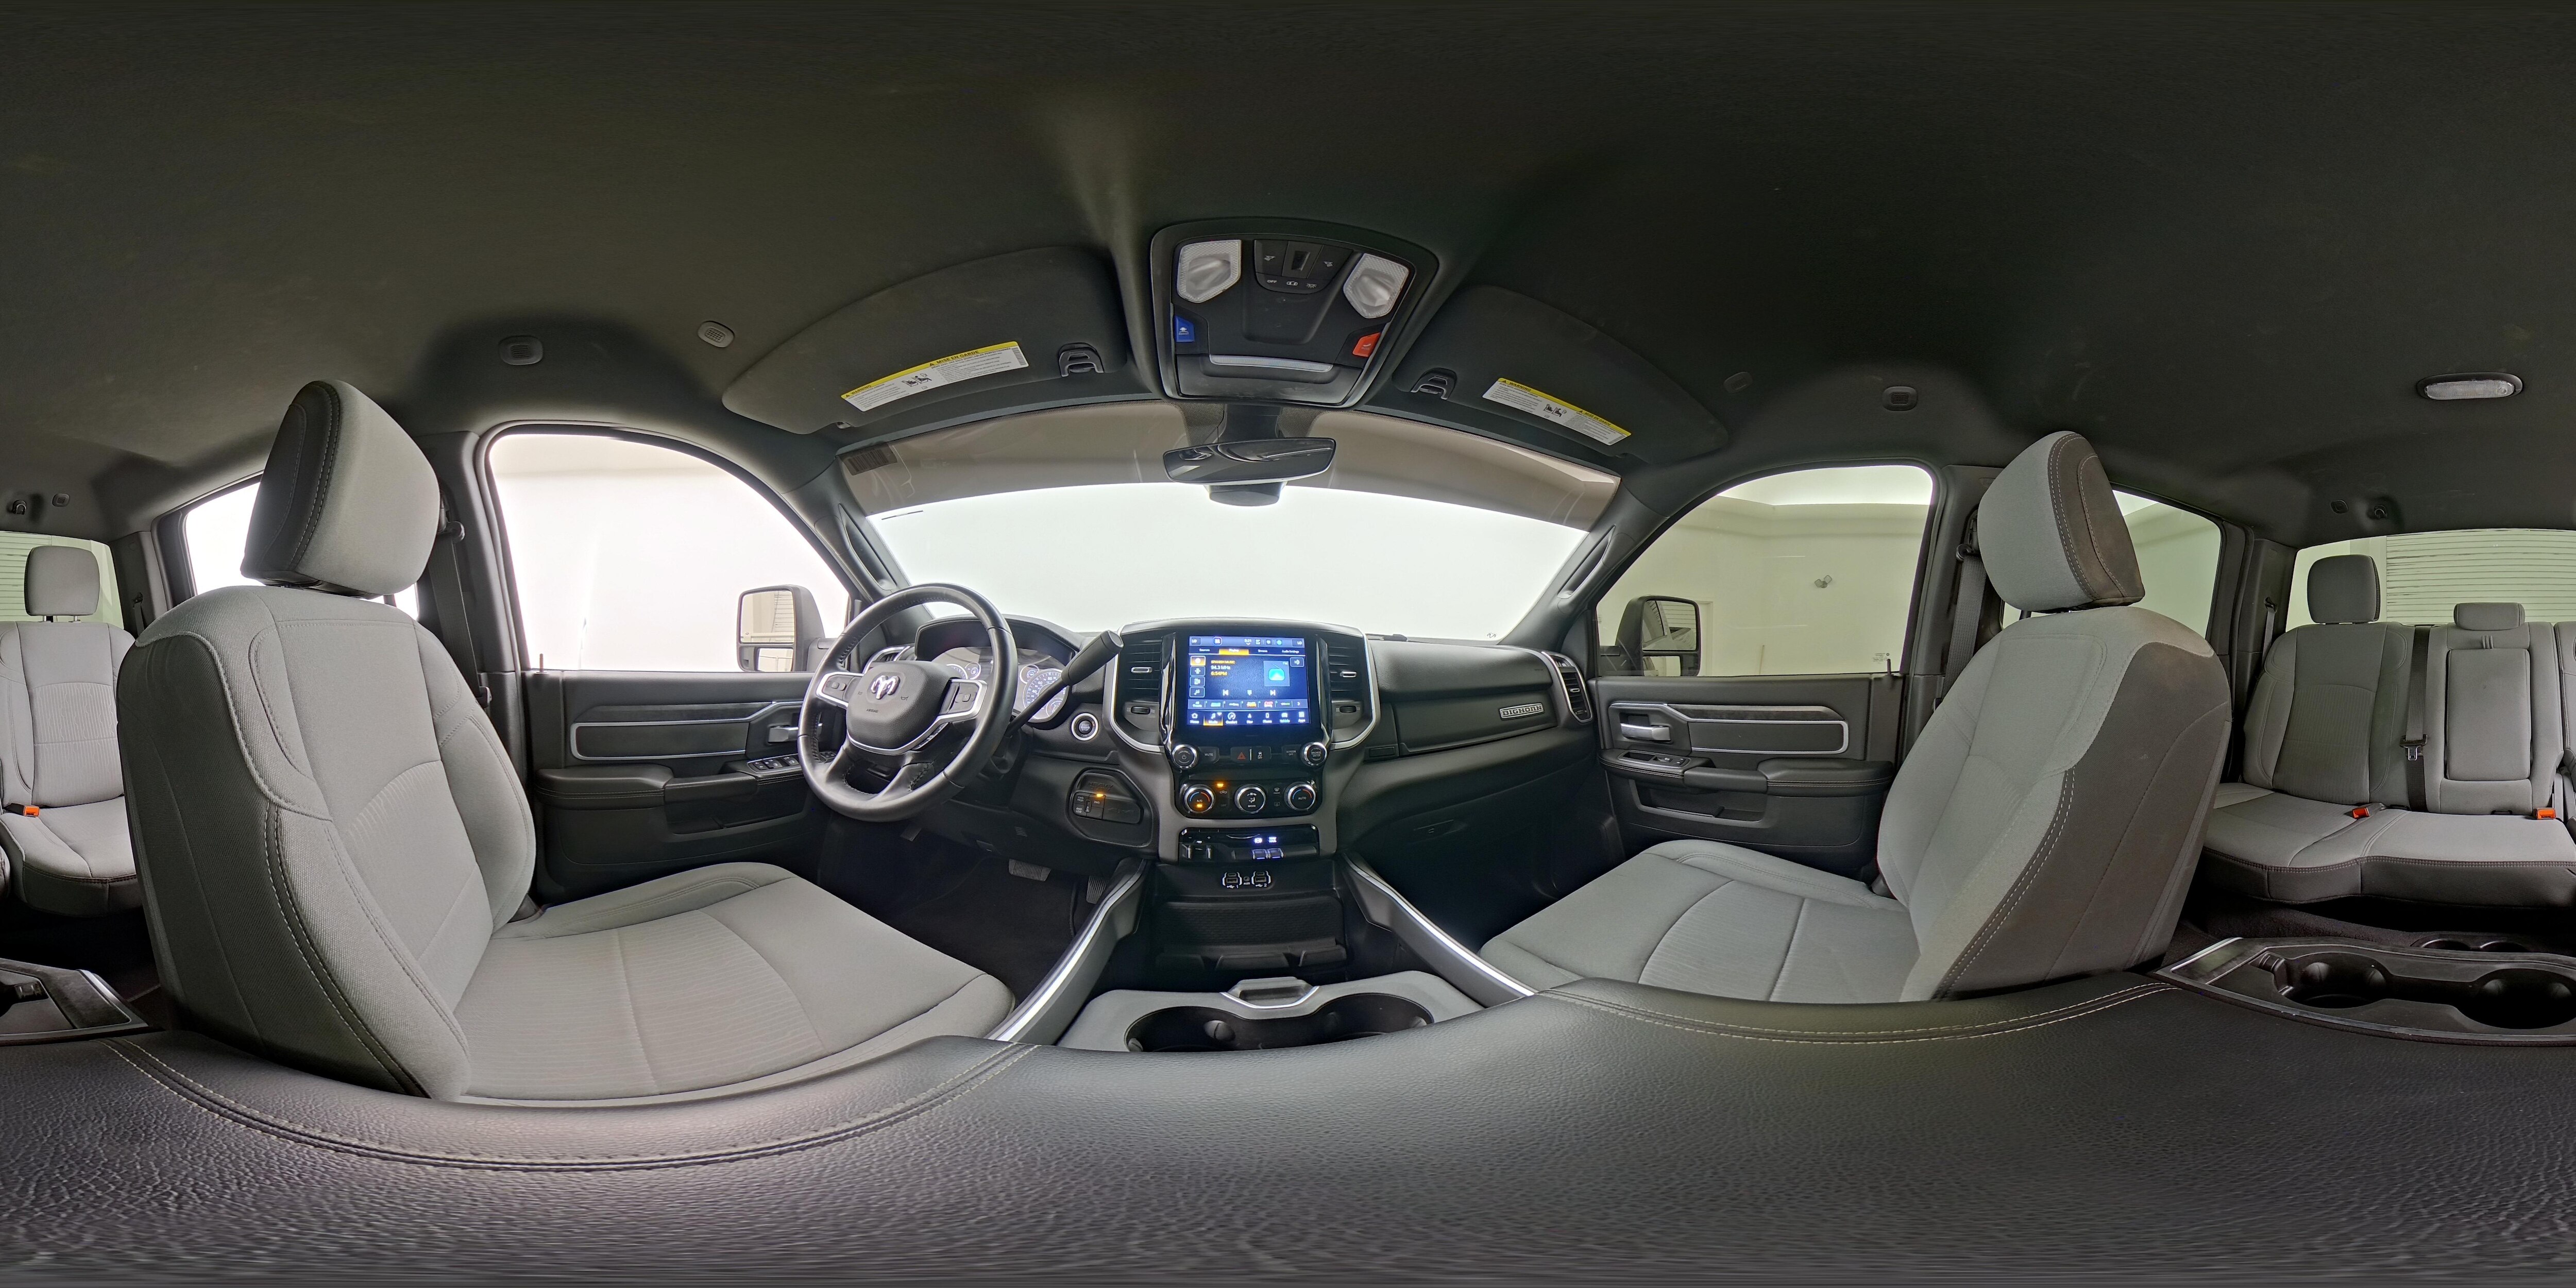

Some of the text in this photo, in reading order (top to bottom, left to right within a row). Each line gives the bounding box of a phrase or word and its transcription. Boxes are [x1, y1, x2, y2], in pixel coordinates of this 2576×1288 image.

[851, 384, 872, 395] WARNING
[1510, 382, 1532, 392] WARNING
[1502, 705, 1543, 716] BIGHORN
